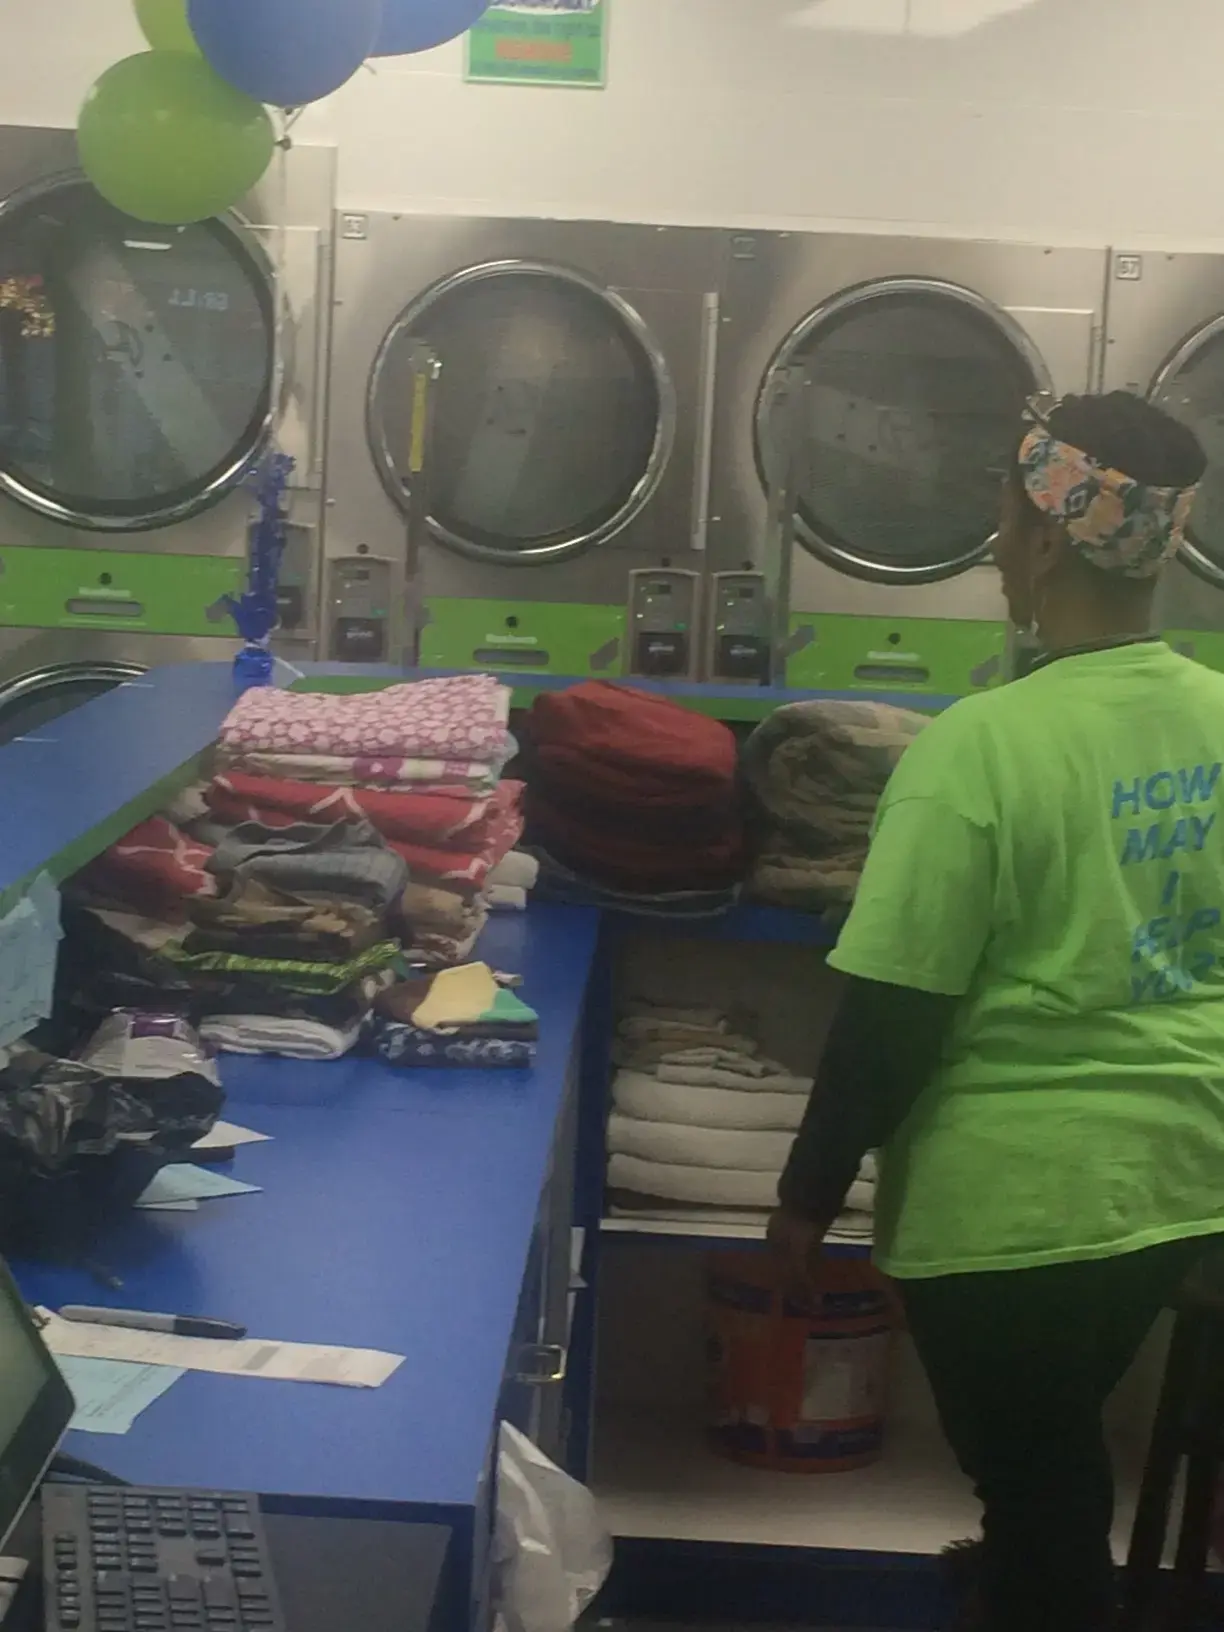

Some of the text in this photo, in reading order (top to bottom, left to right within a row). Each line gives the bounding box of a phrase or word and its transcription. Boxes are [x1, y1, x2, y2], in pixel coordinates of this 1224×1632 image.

[1112, 762, 1222, 819] HOW
[1120, 812, 1216, 866] MAY
[1161, 870, 1180, 905] I
